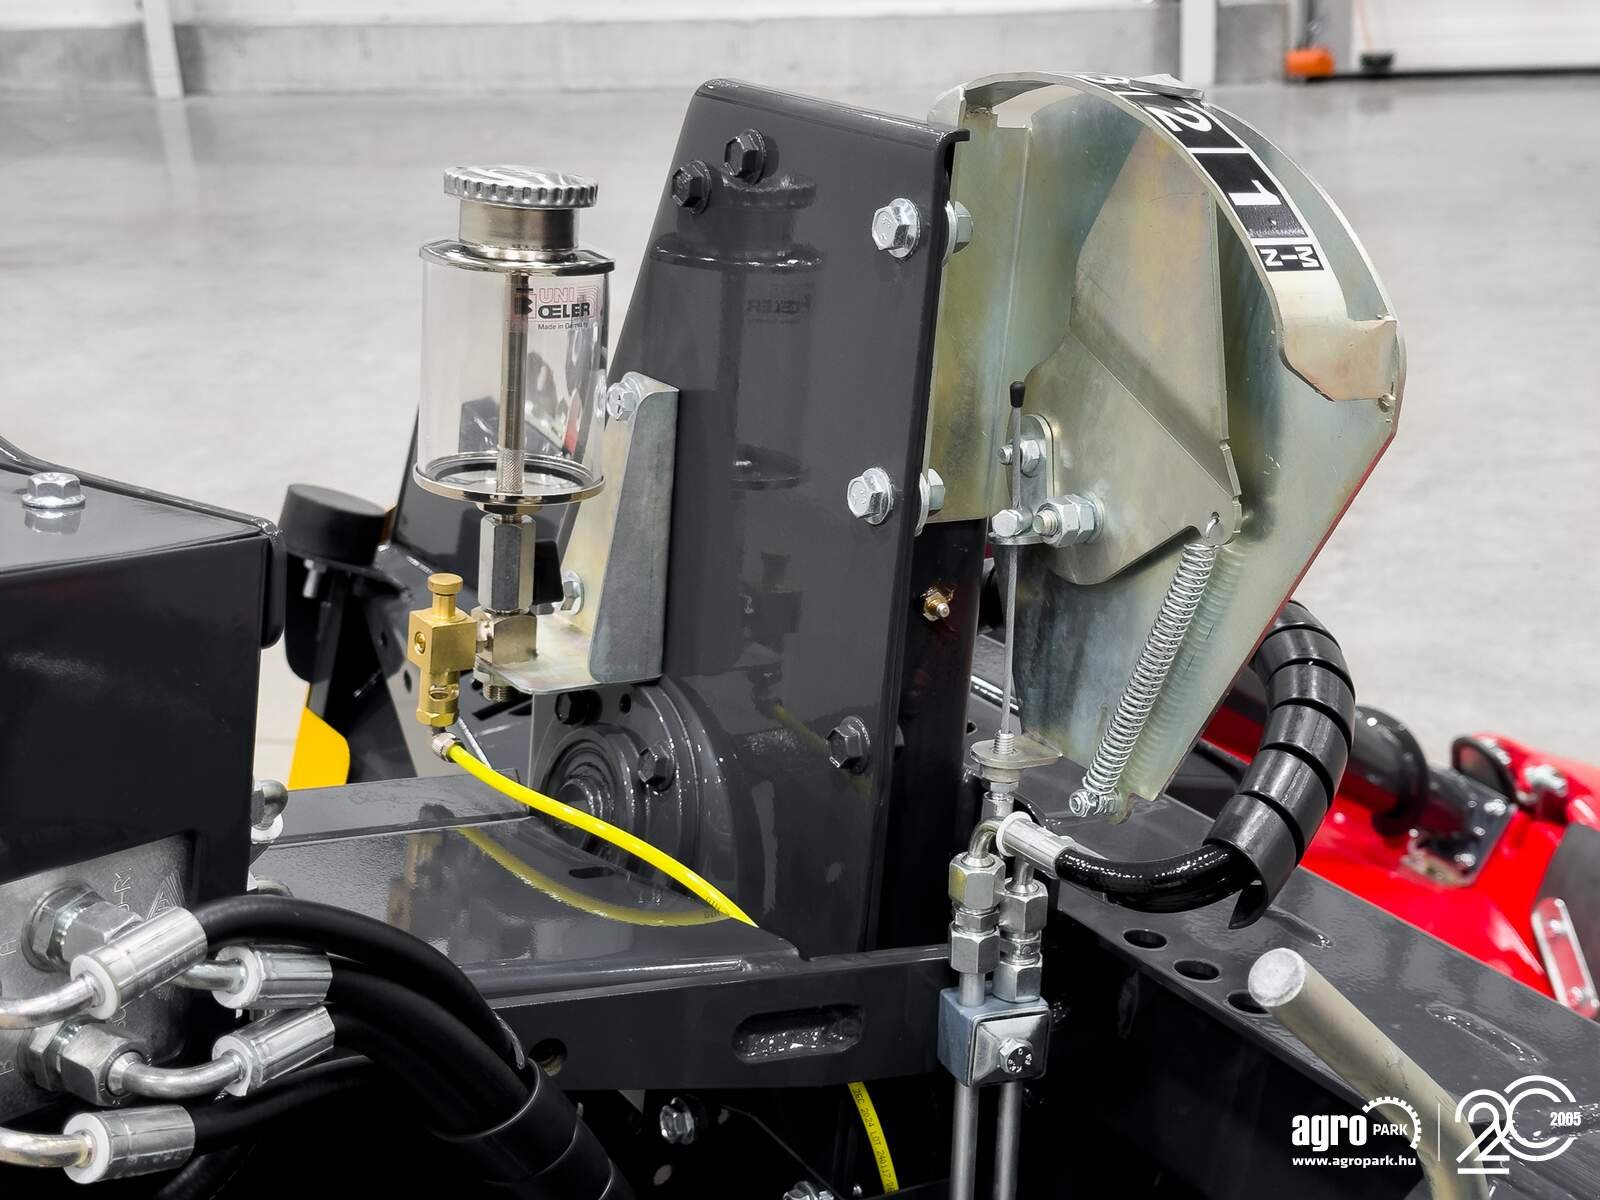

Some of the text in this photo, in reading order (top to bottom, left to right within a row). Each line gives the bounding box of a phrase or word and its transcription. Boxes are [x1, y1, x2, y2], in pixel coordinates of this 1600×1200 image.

[1146, 105, 1213, 132] 2
[1228, 179, 1282, 206] 1
[539, 287, 576, 304] UNI
[870, 1129, 882, 1146] LOT
